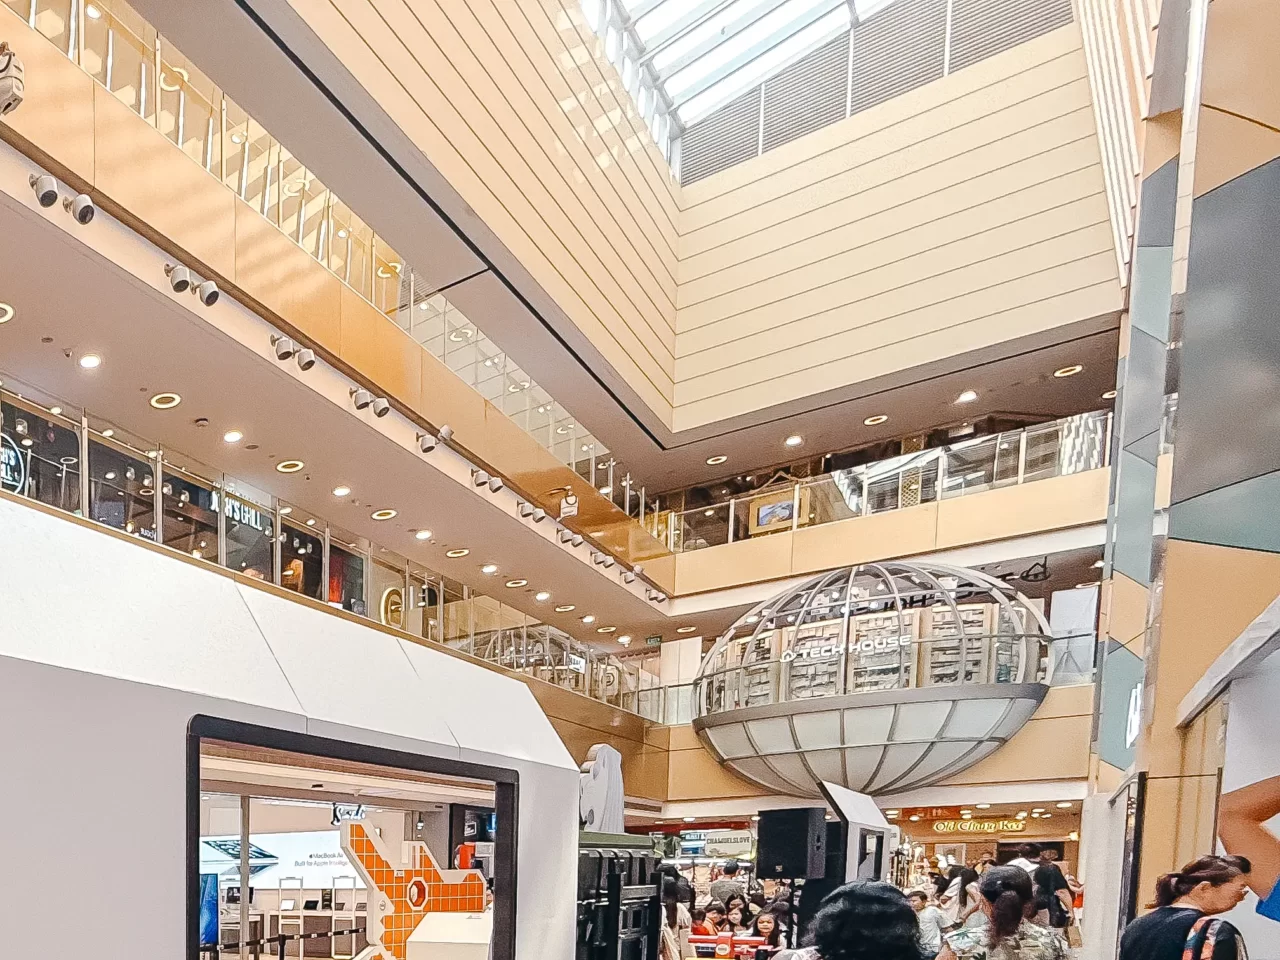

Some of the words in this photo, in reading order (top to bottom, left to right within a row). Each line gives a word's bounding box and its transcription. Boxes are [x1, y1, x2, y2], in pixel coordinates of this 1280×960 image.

[848, 634, 912, 655] HOUSE
[933, 820, 957, 832] Old
[957, 820, 998, 833] Chang
